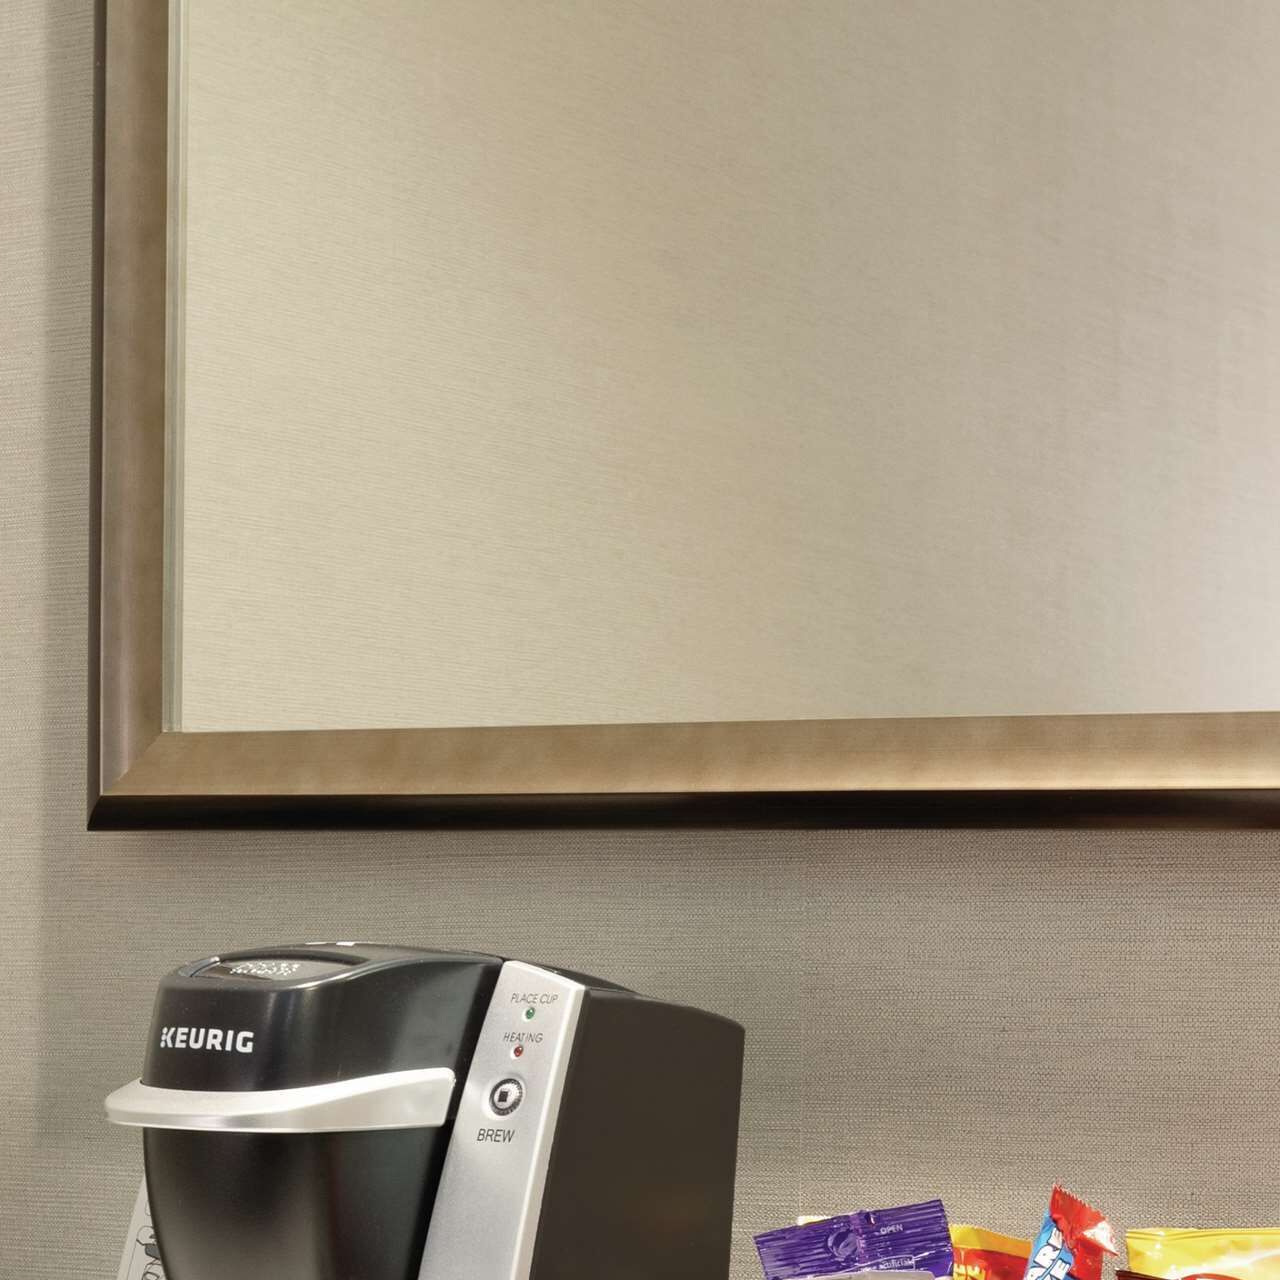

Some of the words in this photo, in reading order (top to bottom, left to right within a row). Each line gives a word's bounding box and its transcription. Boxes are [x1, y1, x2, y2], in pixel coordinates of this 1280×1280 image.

[510, 992, 538, 1004] PLACE
[538, 994, 559, 1004] CUP
[160, 1027, 254, 1053] KEURIG
[503, 1032, 544, 1043] HEATING
[477, 1128, 515, 1143] BREW
